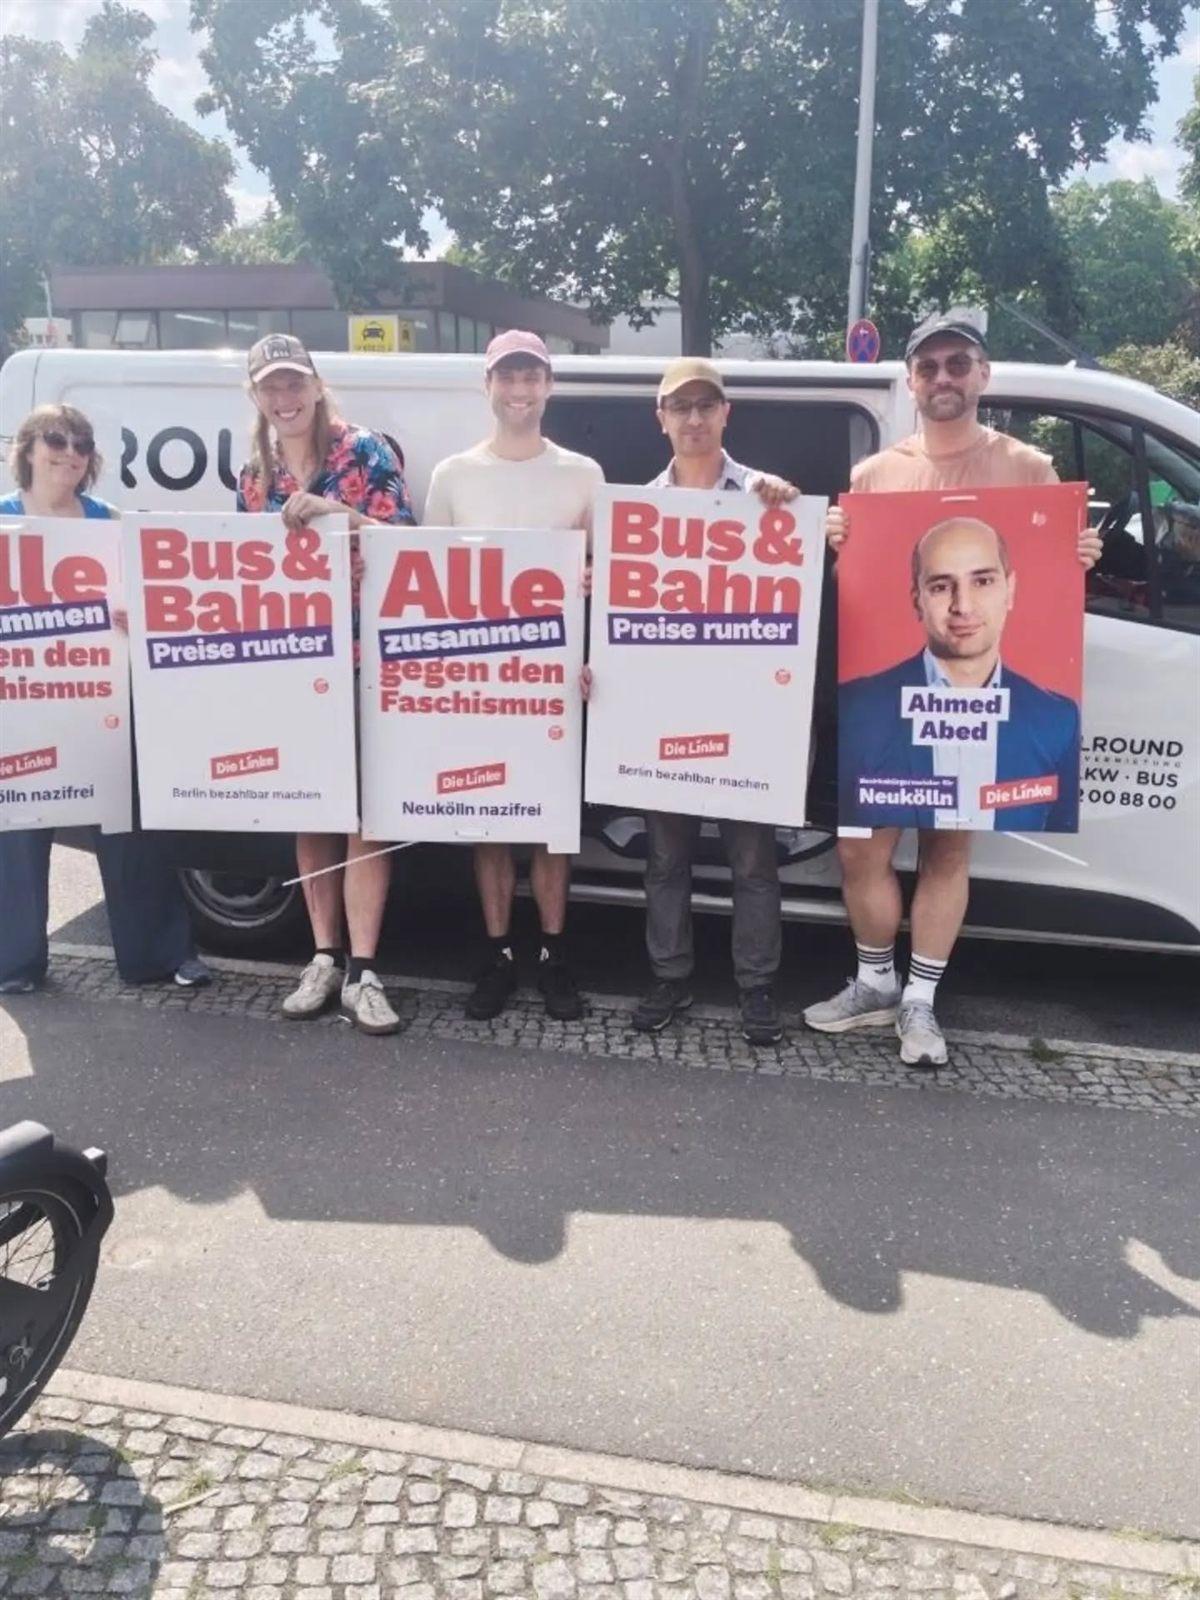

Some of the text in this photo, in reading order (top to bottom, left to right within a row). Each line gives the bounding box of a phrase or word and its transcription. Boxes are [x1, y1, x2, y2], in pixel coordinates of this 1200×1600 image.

[379, 547, 566, 621] Alle
[608, 559, 803, 615] Bahn
[0, 605, 105, 634] mmen
[143, 583, 333, 633] Bahn
[383, 618, 561, 654] zusammen
[612, 617, 792, 642] Preise runter
[44, 640, 111, 668] den
[152, 632, 328, 664] Preise runter
[380, 656, 564, 689] gegen den
[0, 675, 112, 700] hismus
[380, 690, 564, 716] Faschismus
[908, 692, 1003, 715] Ahmed
[919, 720, 988, 741] Abed
[664, 739, 725, 756] Die Linke
[15, 754, 53, 773] Linke
[216, 754, 275, 775] Die Linke
[442, 769, 502, 789] Die Linke
[618, 764, 770, 791] Berlin bezahlbar machen
[1080, 767, 1179, 788] KW BUS
[31, 784, 95, 802] nazifrei
[172, 788, 322, 800] Berlin bezahlbar machen
[859, 787, 954, 806] Neukölln
[985, 780, 1053, 805] Die Linke
[402, 800, 542, 817] Neukölln nazifrei
